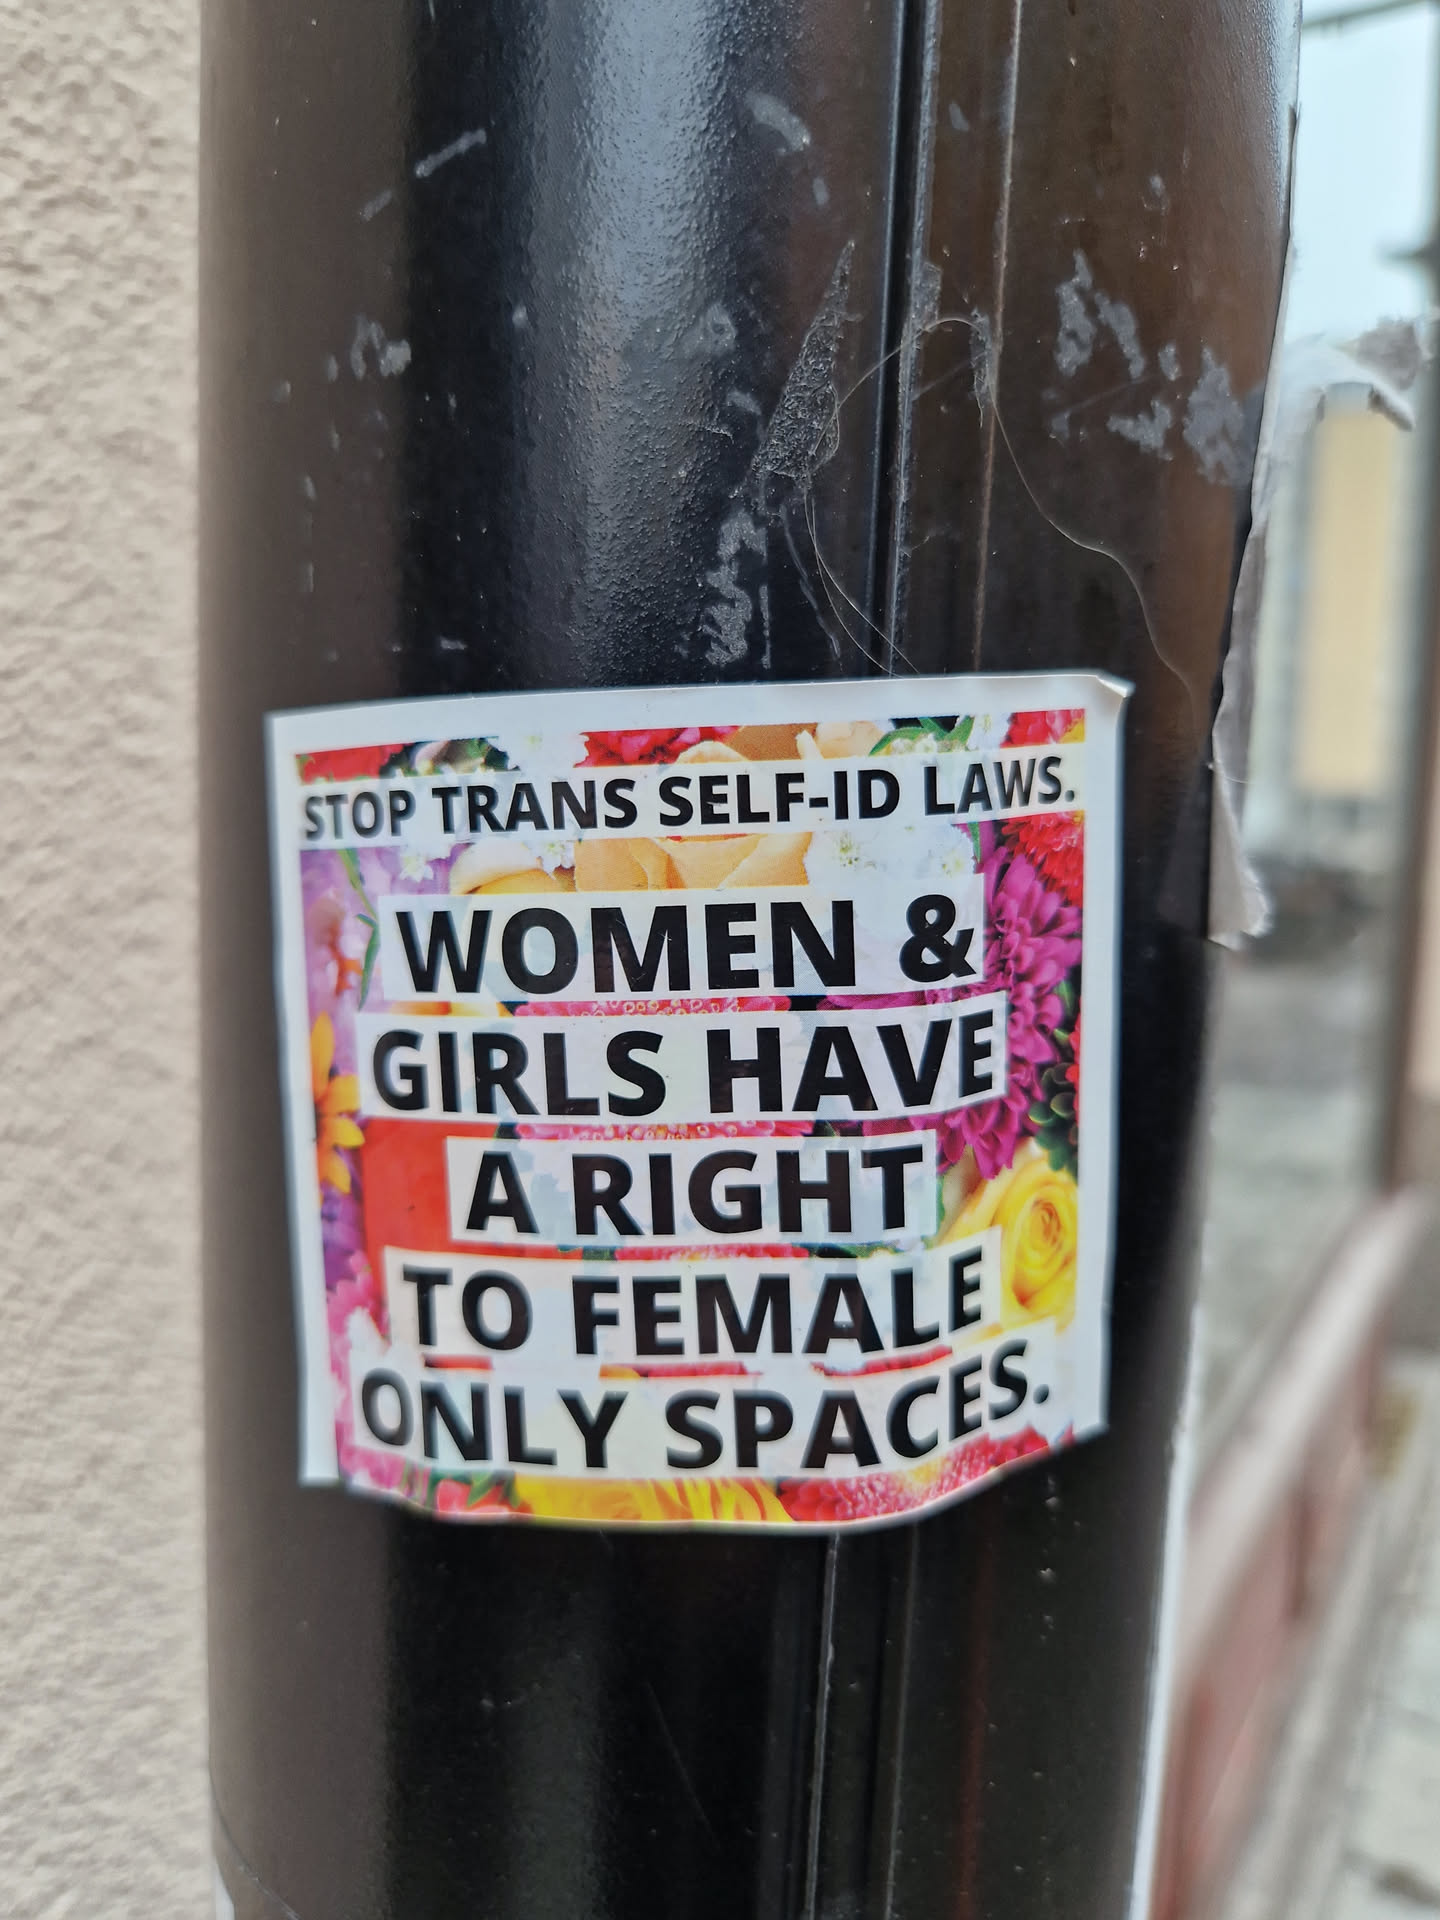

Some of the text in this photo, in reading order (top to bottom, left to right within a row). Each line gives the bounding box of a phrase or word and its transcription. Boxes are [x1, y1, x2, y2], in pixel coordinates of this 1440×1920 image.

[304, 755, 1077, 839] STOP TRANS SELF-ID LAWS.
[395, 892, 978, 995] WOMEN &
[371, 1008, 996, 1119] GIRLS HAVE
[465, 1146, 925, 1236] A RIGHT
[401, 1248, 985, 1358] TO FEMALE
[359, 1338, 1052, 1471] ONLY SPACES.
